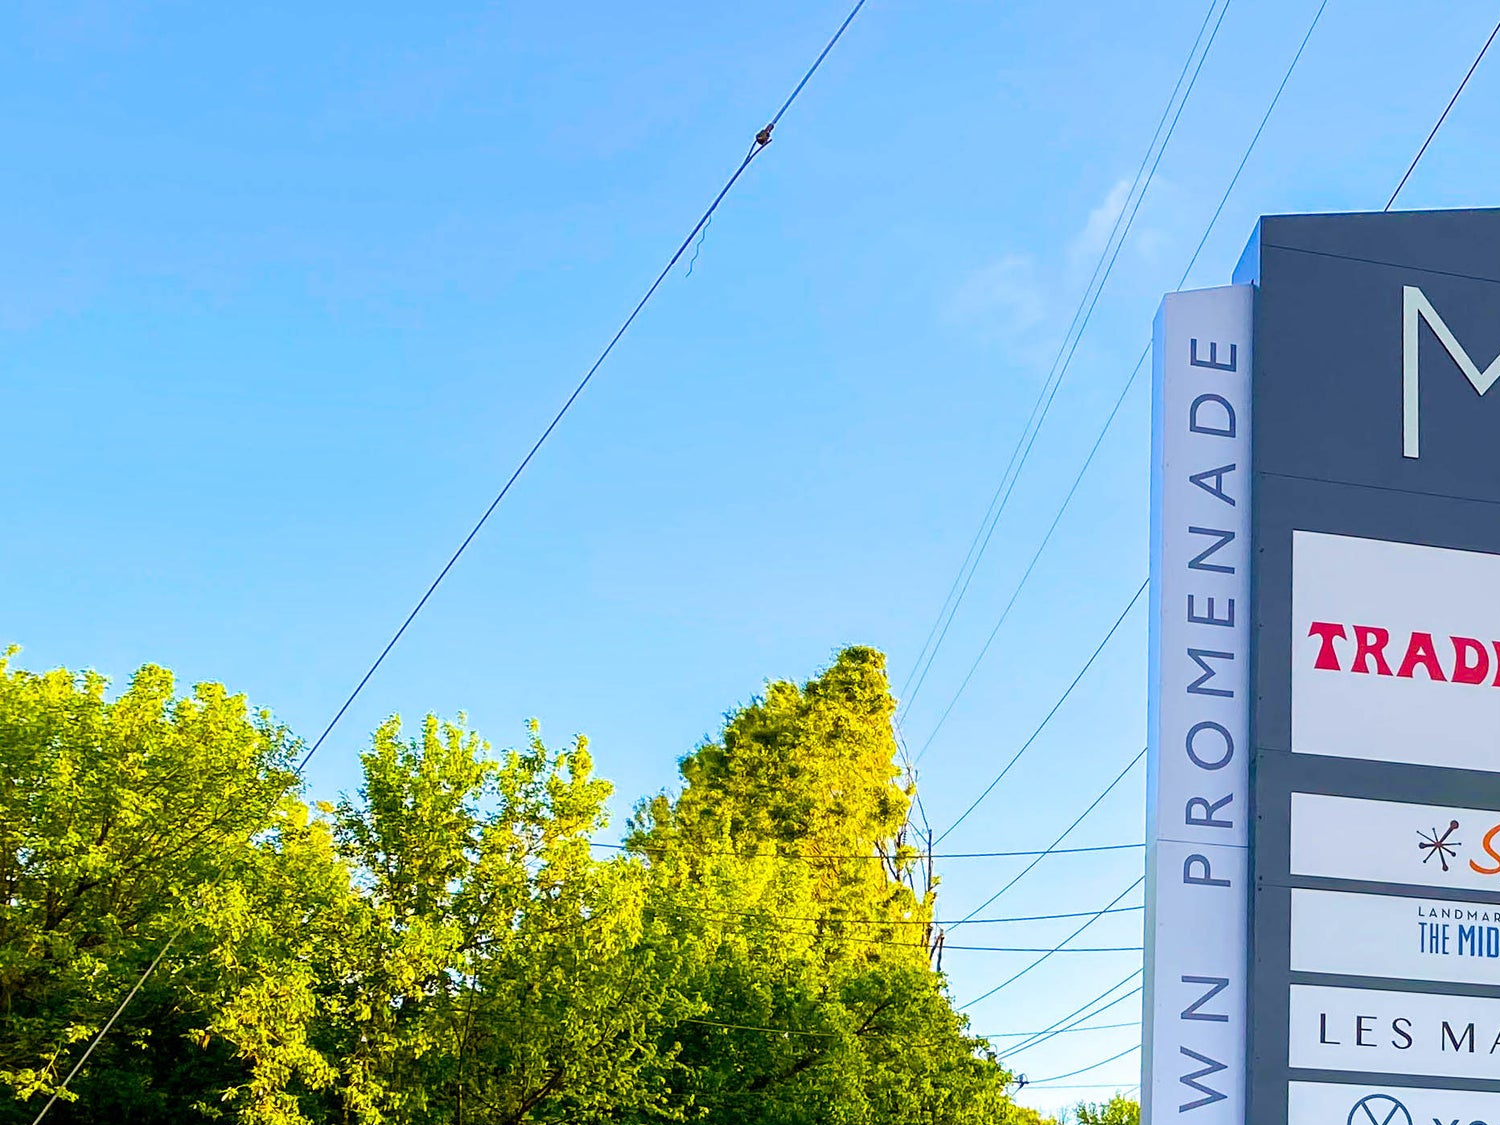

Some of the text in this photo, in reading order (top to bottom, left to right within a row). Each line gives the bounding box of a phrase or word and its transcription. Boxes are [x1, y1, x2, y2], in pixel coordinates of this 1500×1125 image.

[1183, 336, 1238, 888] PROMENADE
[1418, 922, 1450, 955] THE
[1319, 1012, 1414, 1050] LES
